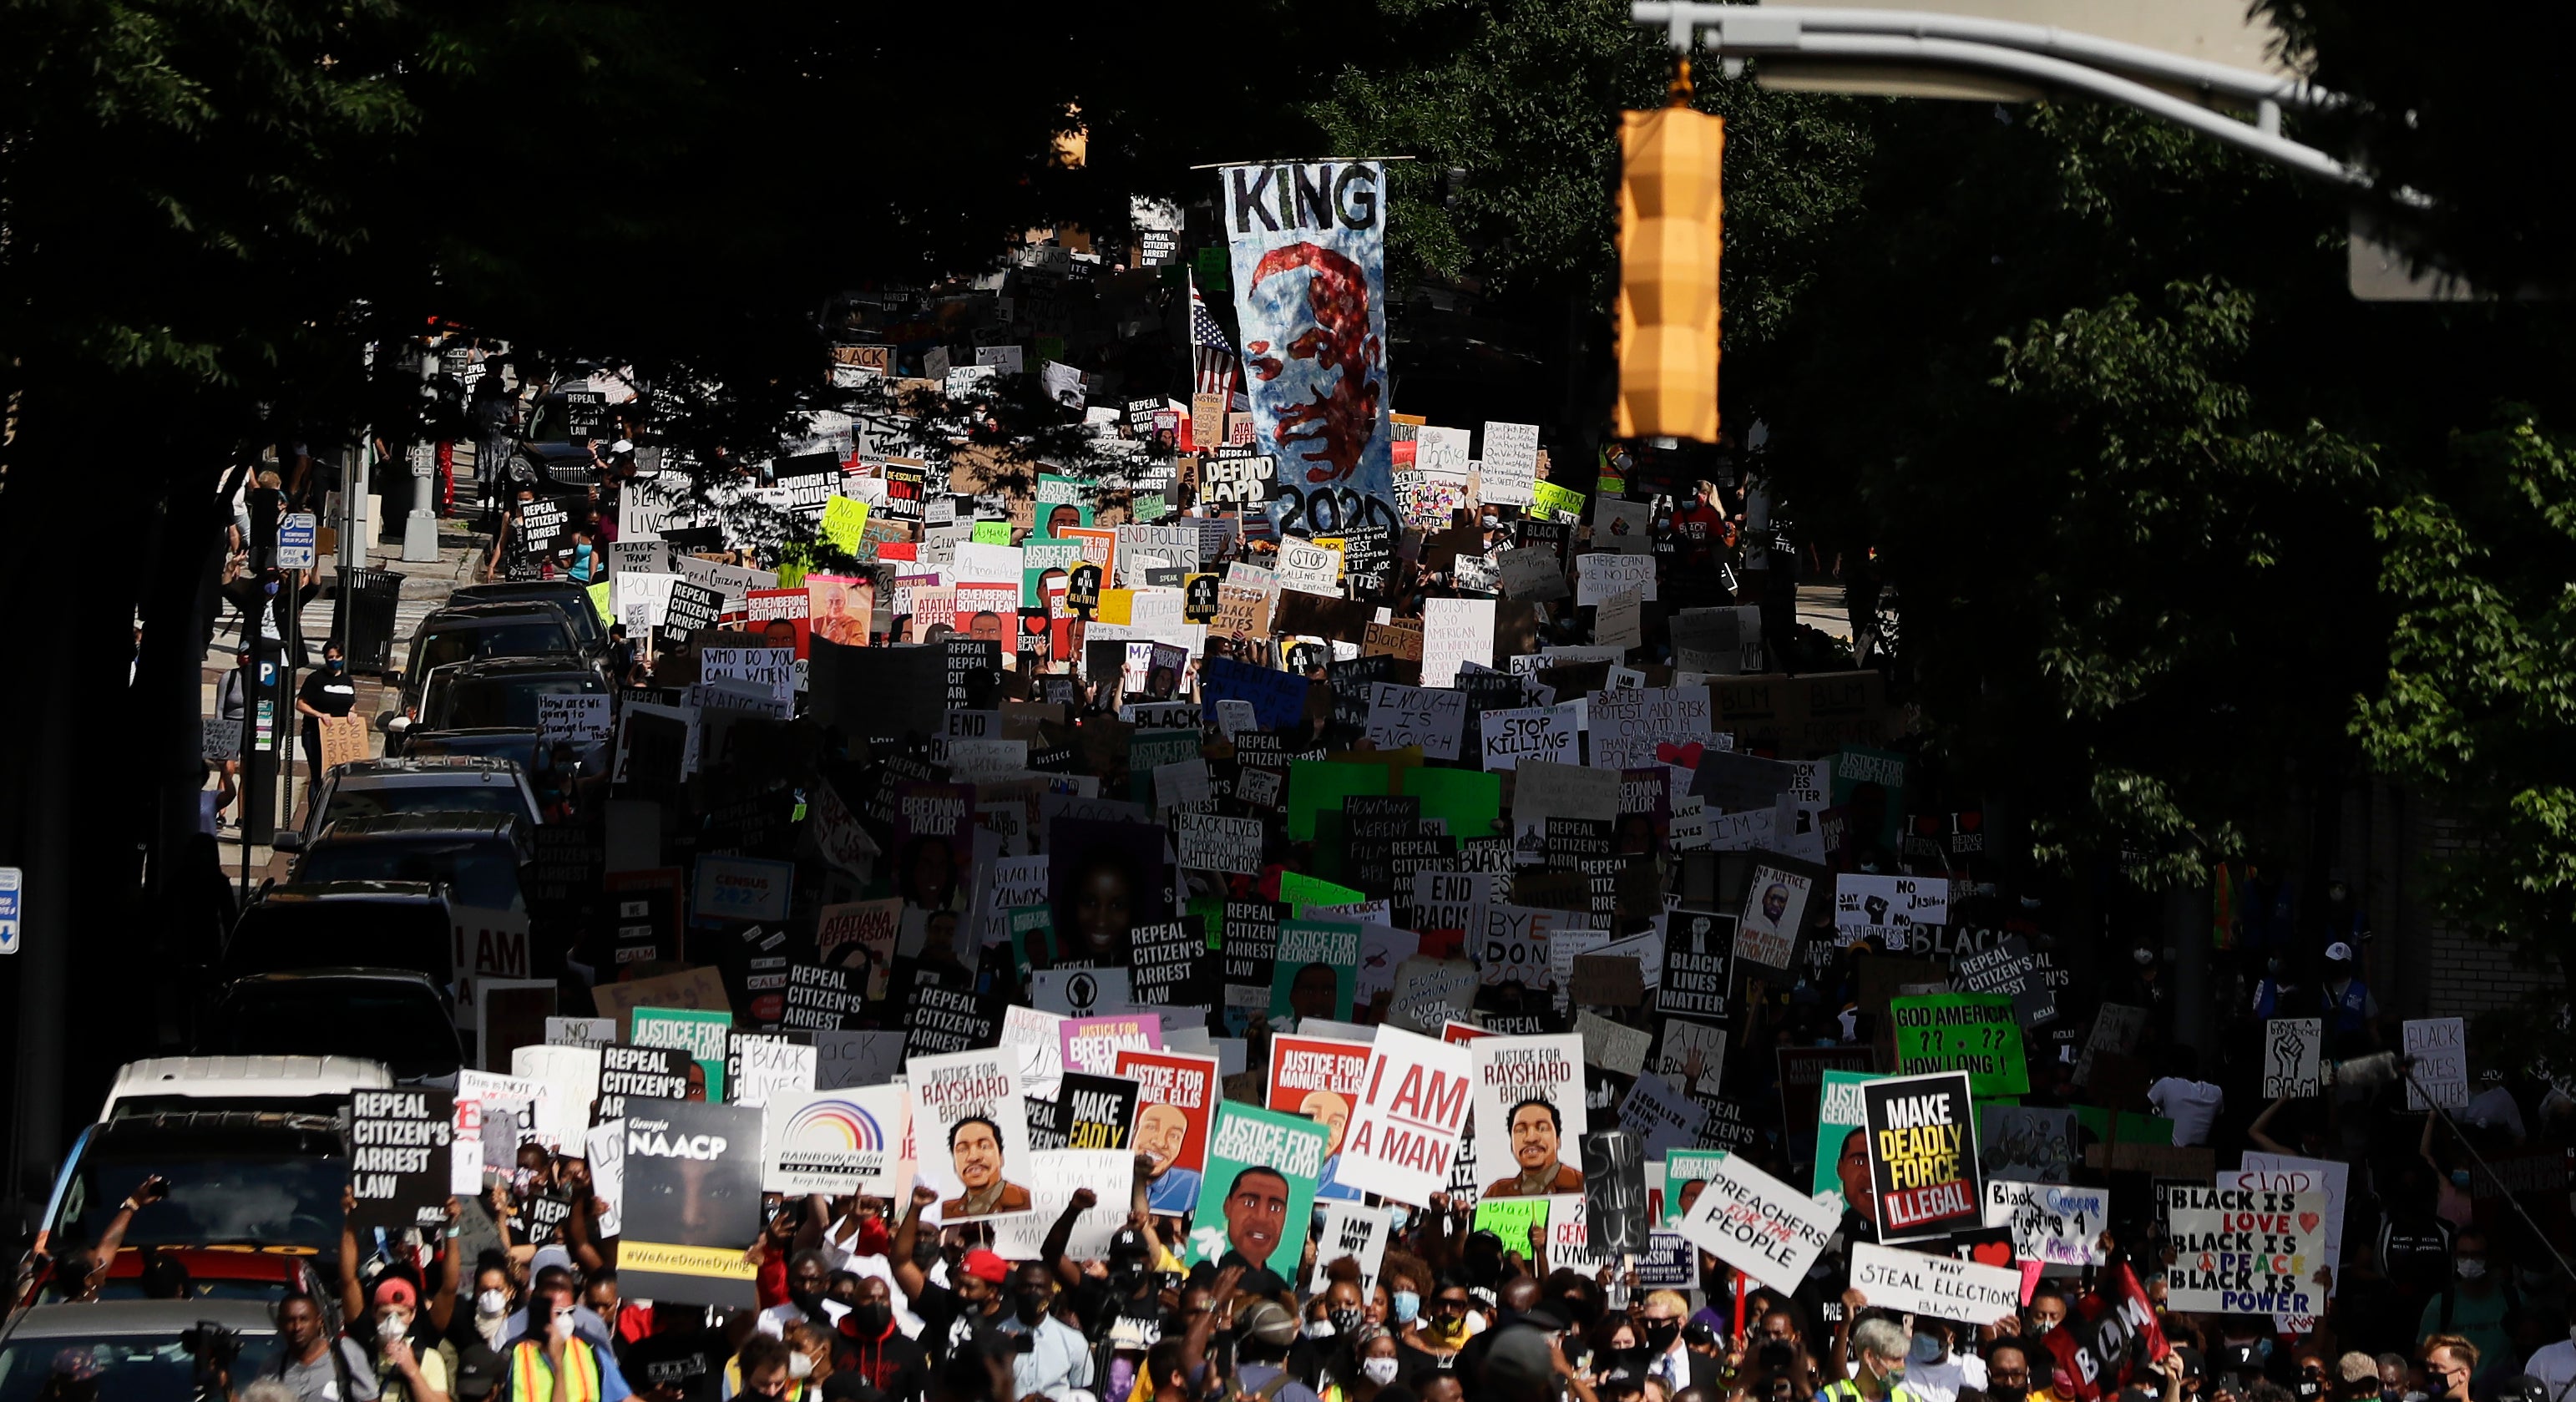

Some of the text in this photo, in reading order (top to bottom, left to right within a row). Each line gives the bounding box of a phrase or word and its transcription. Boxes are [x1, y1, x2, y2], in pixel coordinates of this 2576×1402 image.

[1233, 165, 1377, 231] KING
[1144, 241, 1175, 250] CITIZEN'S
[1018, 250, 1068, 263] DEFUND
[950, 368, 976, 379] END
[568, 394, 597, 404] REPEAL
[1130, 398, 1158, 412] REPEAL
[570, 426, 587, 436] LAW
[887, 471, 923, 483] DE-ESCALATE
[1207, 457, 1273, 483] DEFUND
[777, 472, 839, 489] ENOUGH IS
[1040, 481, 1073, 494] JUSTICE
[1039, 492, 1065, 504] GEORGE
[1215, 481, 1264, 502] APD
[523, 502, 558, 515] REPEAL
[525, 512, 568, 528] CITIZEN'S
[526, 525, 561, 540] ARREST
[1119, 528, 1147, 544] END
[1151, 529, 1196, 545] POLICE
[1528, 525, 1558, 537] BLACK
[529, 539, 549, 552] LAW
[1025, 544, 1081, 559] JUSTICE FOR
[626, 554, 651, 563] TRANS
[1025, 556, 1055, 568] GEORGE
[1296, 549, 1323, 566] STOP
[1587, 556, 1642, 567] THERE CAN
[675, 586, 711, 605] REPEAL
[748, 595, 807, 610] REMEMBERING
[957, 590, 1016, 600] REMEMBERING
[671, 599, 719, 621] CITIZEN'S
[748, 607, 808, 621] BOTHAM JEAN
[957, 600, 1016, 613] BOTHAM JEAN
[1218, 606, 1254, 617] BLACK
[1426, 600, 1470, 613] RACISM
[667, 612, 707, 630] ARREST
[664, 626, 688, 643] LAW
[1427, 627, 1475, 638] AMERICAN
[705, 649, 795, 666] WHO DO YOU
[949, 643, 987, 655] REPEAL
[539, 697, 563, 709] How
[1588, 701, 1706, 721] PROTEST AND RISK
[949, 714, 985, 736] END
[1136, 708, 1202, 728] BLACK
[1402, 712, 1431, 726] IS
[1504, 719, 1551, 736] STOP
[1238, 735, 1282, 749] REPEAL
[1486, 731, 1568, 754] KILLING
[902, 797, 965, 817] BREONNA
[909, 816, 957, 834] TAYLOR
[1181, 816, 1259, 837] BLACK LIVES
[1550, 820, 1596, 837] REPEAL
[1392, 839, 1439, 856] REPEAL
[1549, 838, 1609, 853] CITIZEN'S
[716, 874, 768, 888] CENSUS
[1431, 876, 1472, 901] END
[1897, 881, 1916, 893] NO
[1227, 903, 1274, 921] REPEAL
[1131, 924, 1187, 945] REPEAL
[1488, 911, 1548, 940] BYE
[1280, 929, 1357, 949] JUSTICE FOR
[1134, 942, 1203, 966] CITIZEN'S
[1227, 940, 1275, 959] ARREST
[1278, 946, 1357, 965] GEORGE FLOYD
[1486, 942, 1548, 964] DON
[1226, 960, 1253, 975] LAW
[1671, 952, 1722, 974] BLACK
[1961, 946, 2012, 975] REPEAL
[791, 964, 848, 989] REPEAL
[1136, 964, 1192, 985] ARREST
[1673, 971, 1717, 990] LIVES
[787, 985, 862, 1013] CITIZEN'S
[922, 989, 977, 1014] REPEAL
[1662, 989, 1723, 1012] MATTER
[2033, 1007, 2054, 1020] ACLU
[636, 1019, 726, 1041] JUSTICE FOR
[1079, 1022, 1138, 1038] JUSTICE FOR
[2053, 1030, 2074, 1039] ACLU
[2409, 1026, 2458, 1050] BLACK
[605, 1048, 669, 1073] REPEAL
[752, 1047, 806, 1070] BLACK
[1494, 1050, 1560, 1063] JUSTICE FOR
[930, 1063, 998, 1084] JUSTICE FOR
[1126, 1064, 1203, 1091] JUSTICE FOR
[1485, 1063, 1571, 1084] RAYSHARD
[602, 1075, 686, 1099] CITIZEN'S
[924, 1077, 1009, 1106] RAYSHARD
[1365, 1054, 1470, 1128] I AM
[1500, 1085, 1557, 1103] BROOKS
[355, 1091, 429, 1119] REPEAL
[1072, 1090, 1121, 1125] MAKE
[1169, 1091, 1201, 1108] ELLIS
[939, 1101, 997, 1123] BROOKS
[1886, 1093, 1951, 1131] MAKE
[354, 1121, 450, 1146] CITIZEN'S
[629, 1117, 668, 1131] Georgia
[1221, 1115, 1323, 1156] JUSTICE FOR
[1880, 1123, 1963, 1162] DEADLY
[628, 1132, 727, 1159] NAACP
[1351, 1121, 1450, 1175] A MAN
[353, 1148, 431, 1173] ARREST
[782, 1151, 843, 1163] RAINBOW
[1214, 1139, 1318, 1179] GEORGE FLOYD
[786, 1164, 875, 1175] COALITION
[1890, 1153, 1960, 1189] FORCE
[354, 1176, 397, 1199] LAW
[792, 1176, 815, 1186] Keep
[817, 1177, 838, 1187] Hope
[1710, 1174, 1828, 1248] PREACHERS
[1886, 1182, 1971, 1225] ILLEGAL
[2172, 1191, 2295, 1212] BLACK IS
[2223, 1213, 2290, 1233] LOVE
[1706, 1209, 1797, 1268] PEOPLE
[2172, 1233, 2296, 1253] BLACK IS
[627, 1251, 750, 1273] #WeAreDoneDying
[1924, 1259, 1964, 1275] THEY
[2220, 1253, 2305, 1273] PEACE
[1860, 1264, 2018, 1308] STEAL ELECTIONS
[2171, 1272, 2295, 1293] BLACK IS
[2222, 1292, 2309, 1312] POWER
